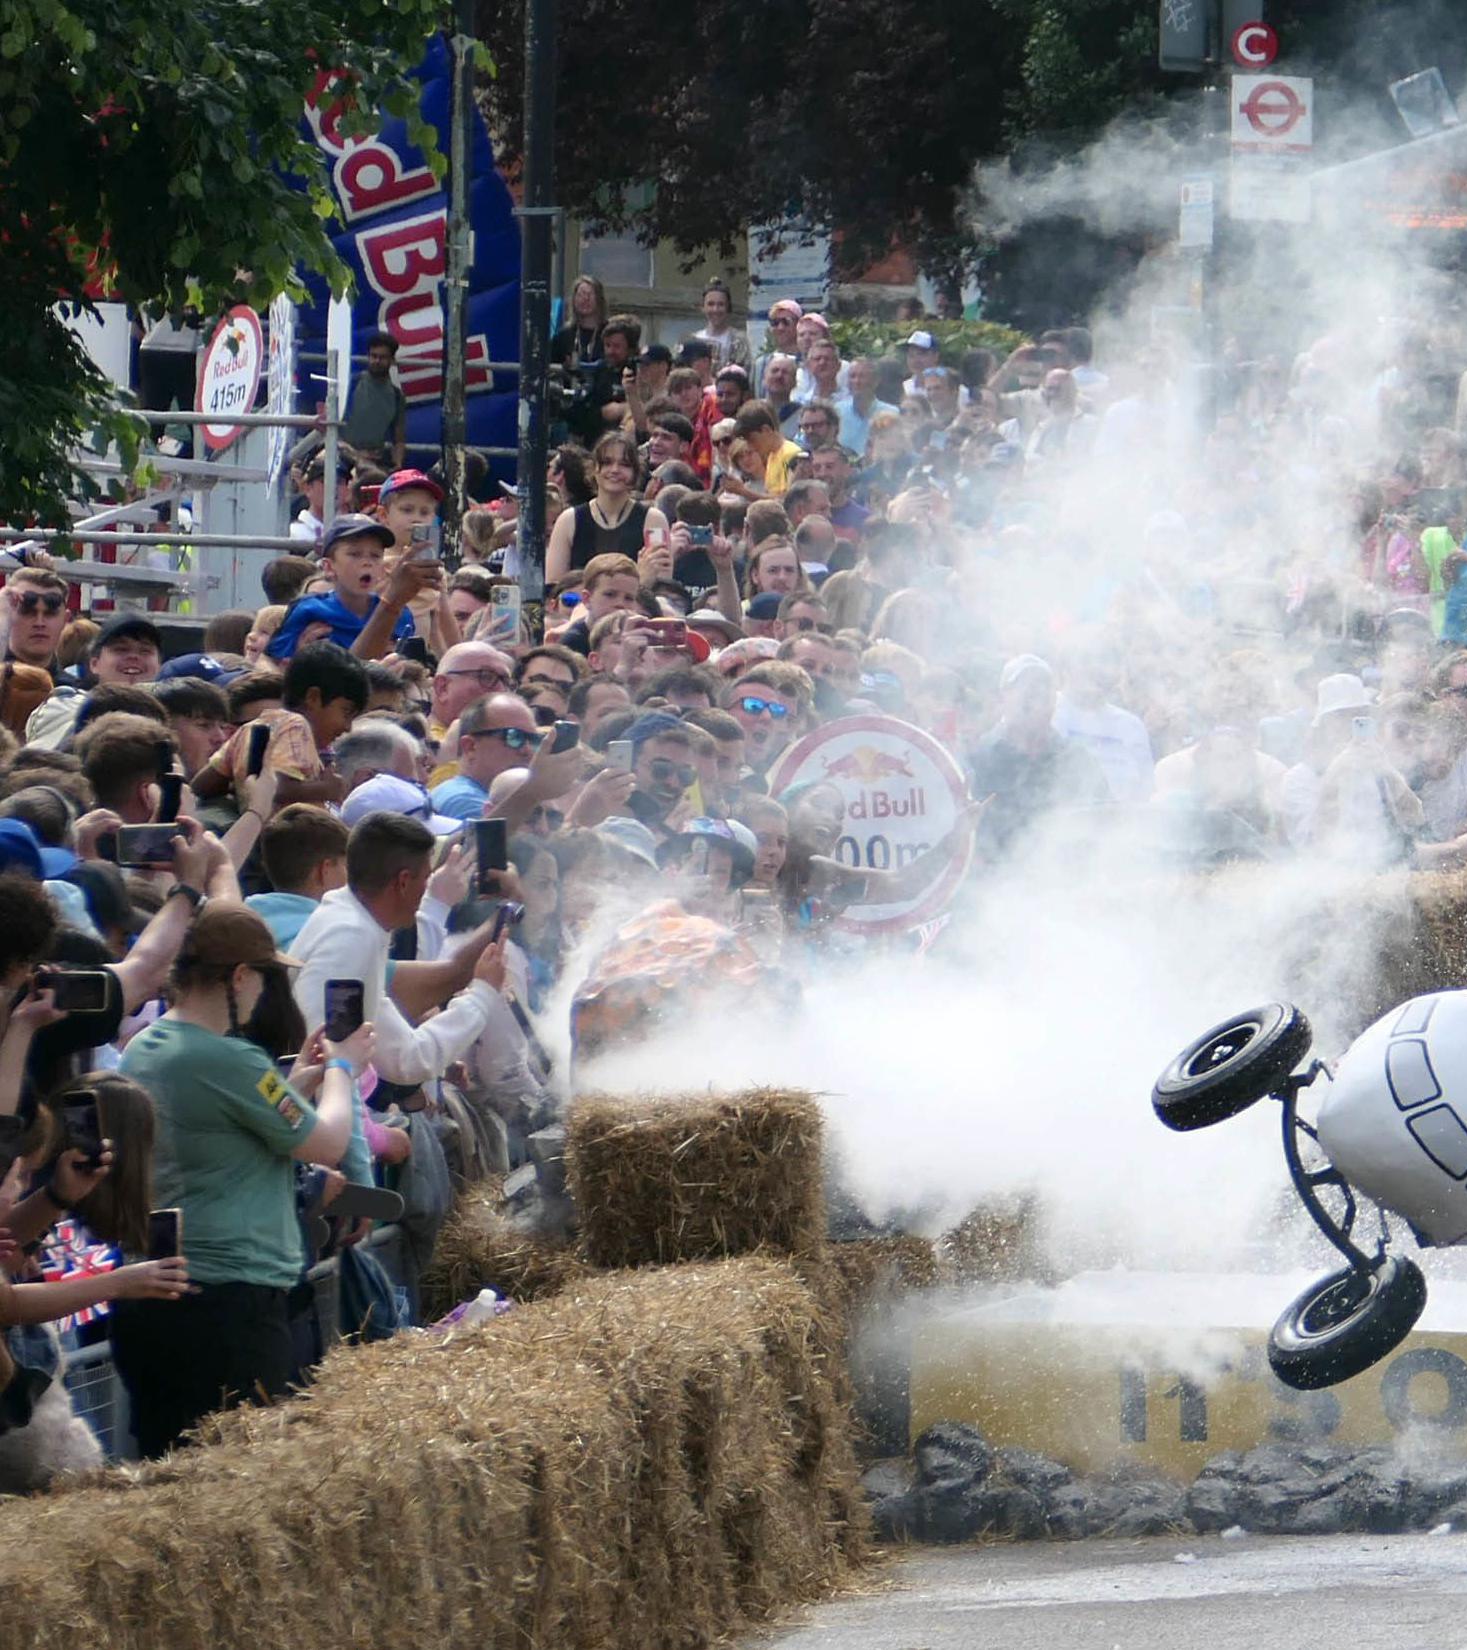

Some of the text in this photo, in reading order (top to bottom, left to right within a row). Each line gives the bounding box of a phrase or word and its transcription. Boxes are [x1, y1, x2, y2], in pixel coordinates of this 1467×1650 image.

[1238, 27, 1268, 62] C
[213, 349, 249, 379] Red Bull
[210, 382, 246, 413] 415m
[872, 788, 926, 818] Bull
